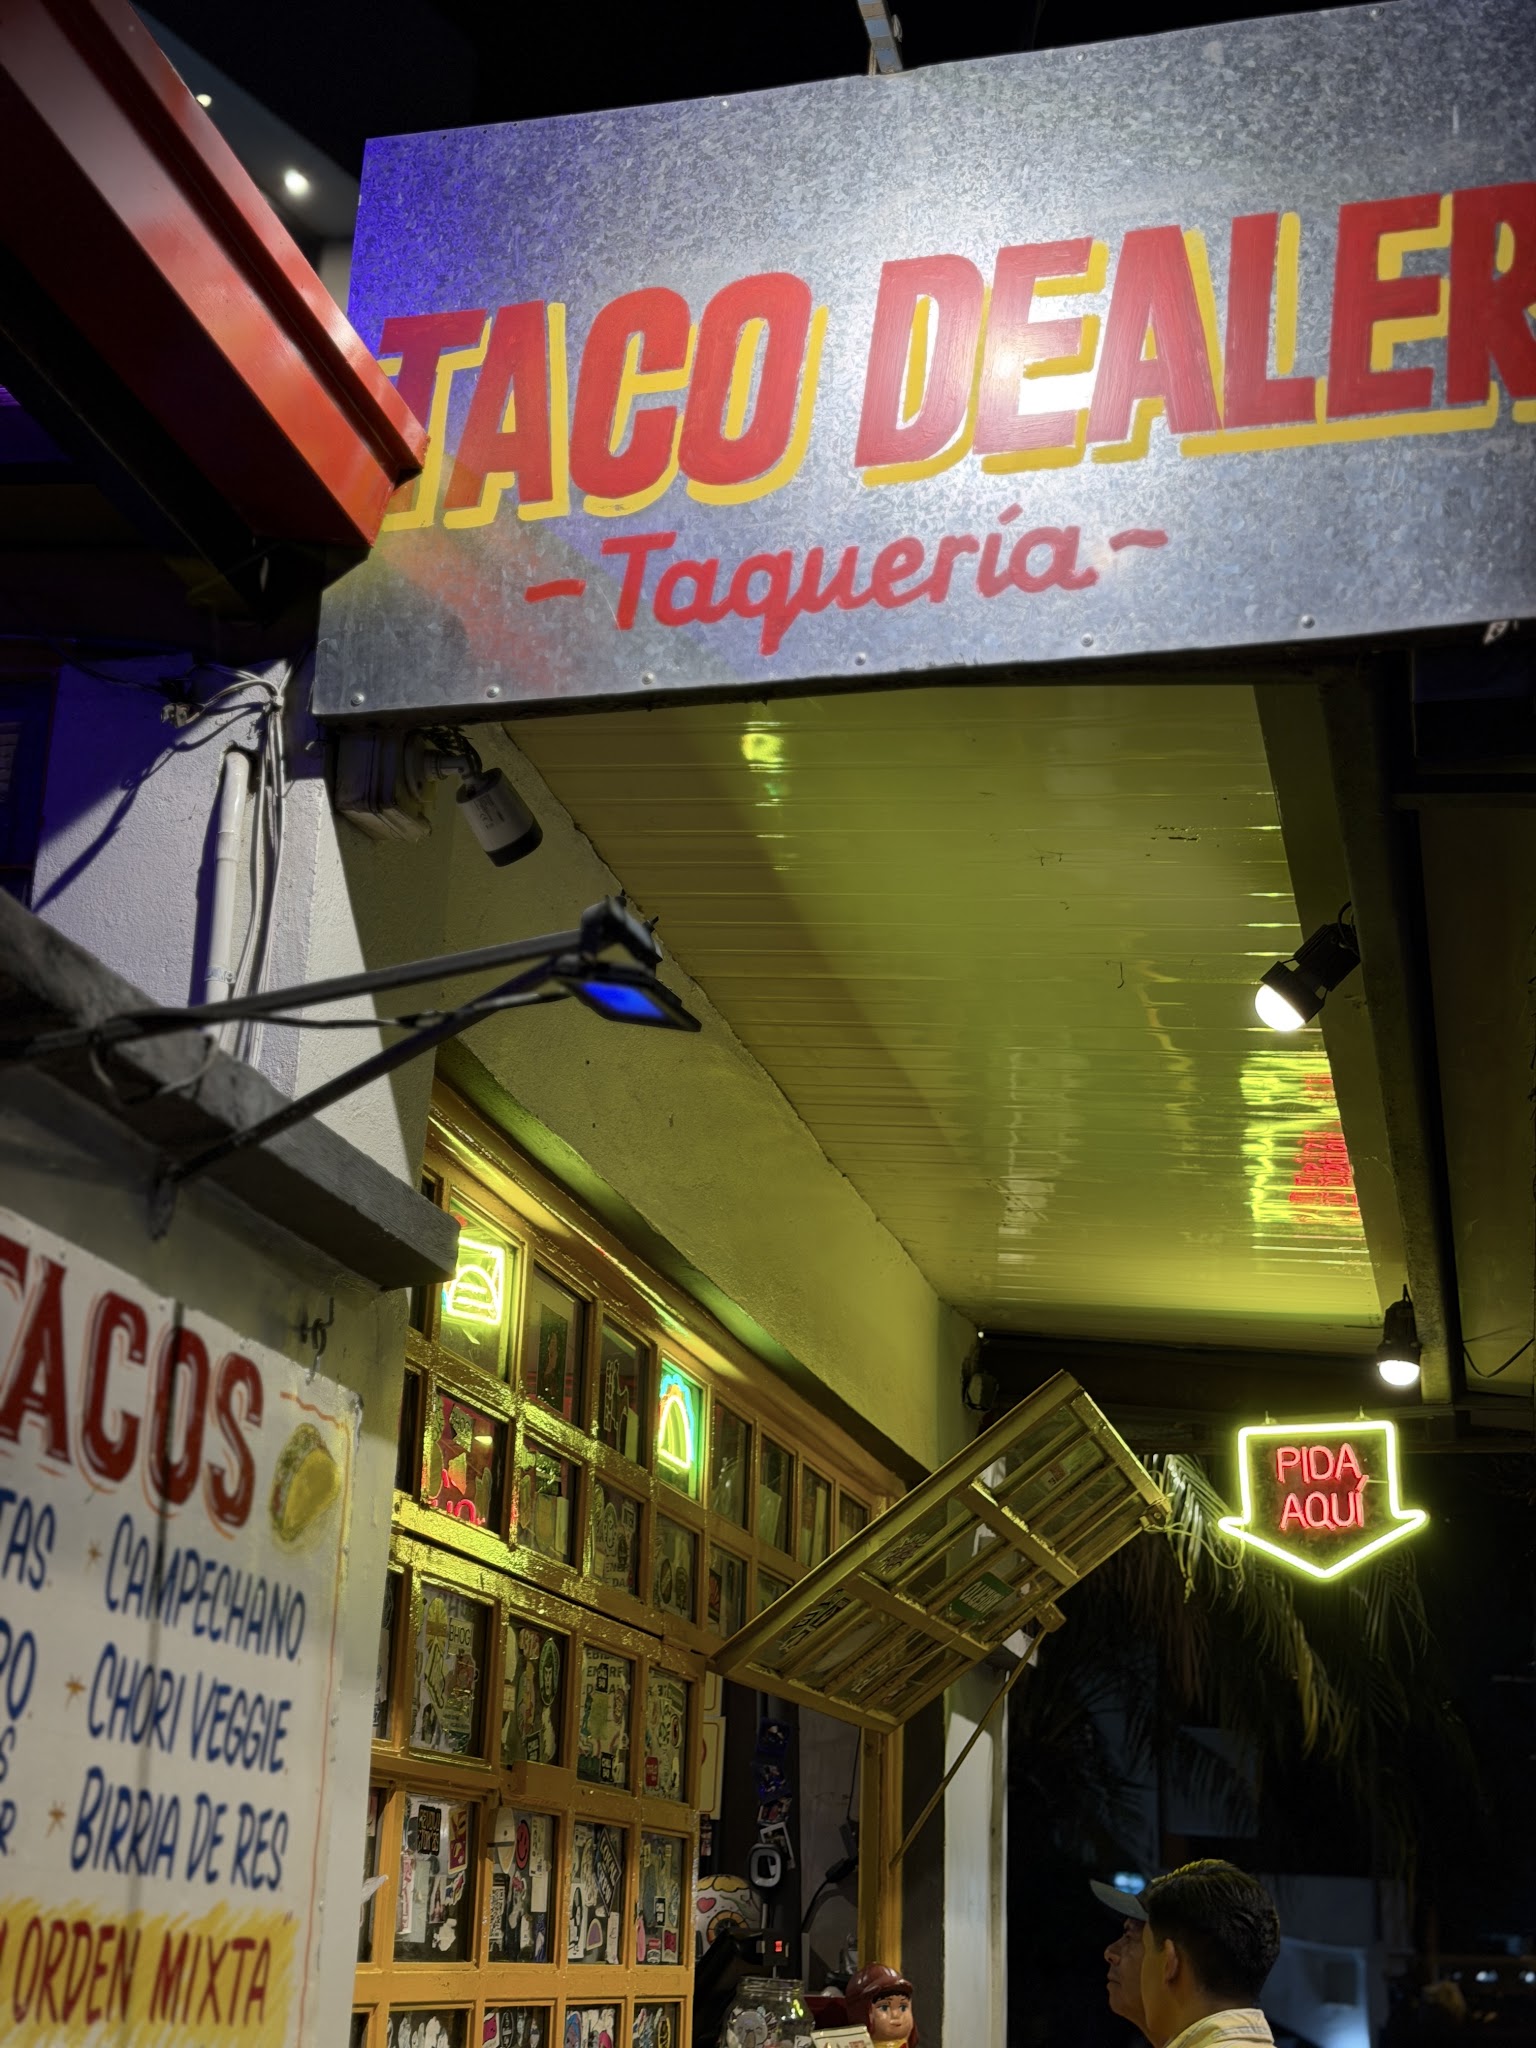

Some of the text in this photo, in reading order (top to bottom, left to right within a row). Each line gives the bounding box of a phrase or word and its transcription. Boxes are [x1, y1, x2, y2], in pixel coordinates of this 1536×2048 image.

[378, 181, 1536, 532] TACO DEALER
[1276, 1442, 1362, 1483] PIDA
[1278, 1474, 1370, 1531] AQUÍ
[104, 1512, 306, 1662] CAMPECHANO
[87, 1641, 292, 1774] CHORI VEGGIE
[70, 1766, 289, 1892] BIRRIA DE RES
[12, 1914, 142, 2026] ORDEN
